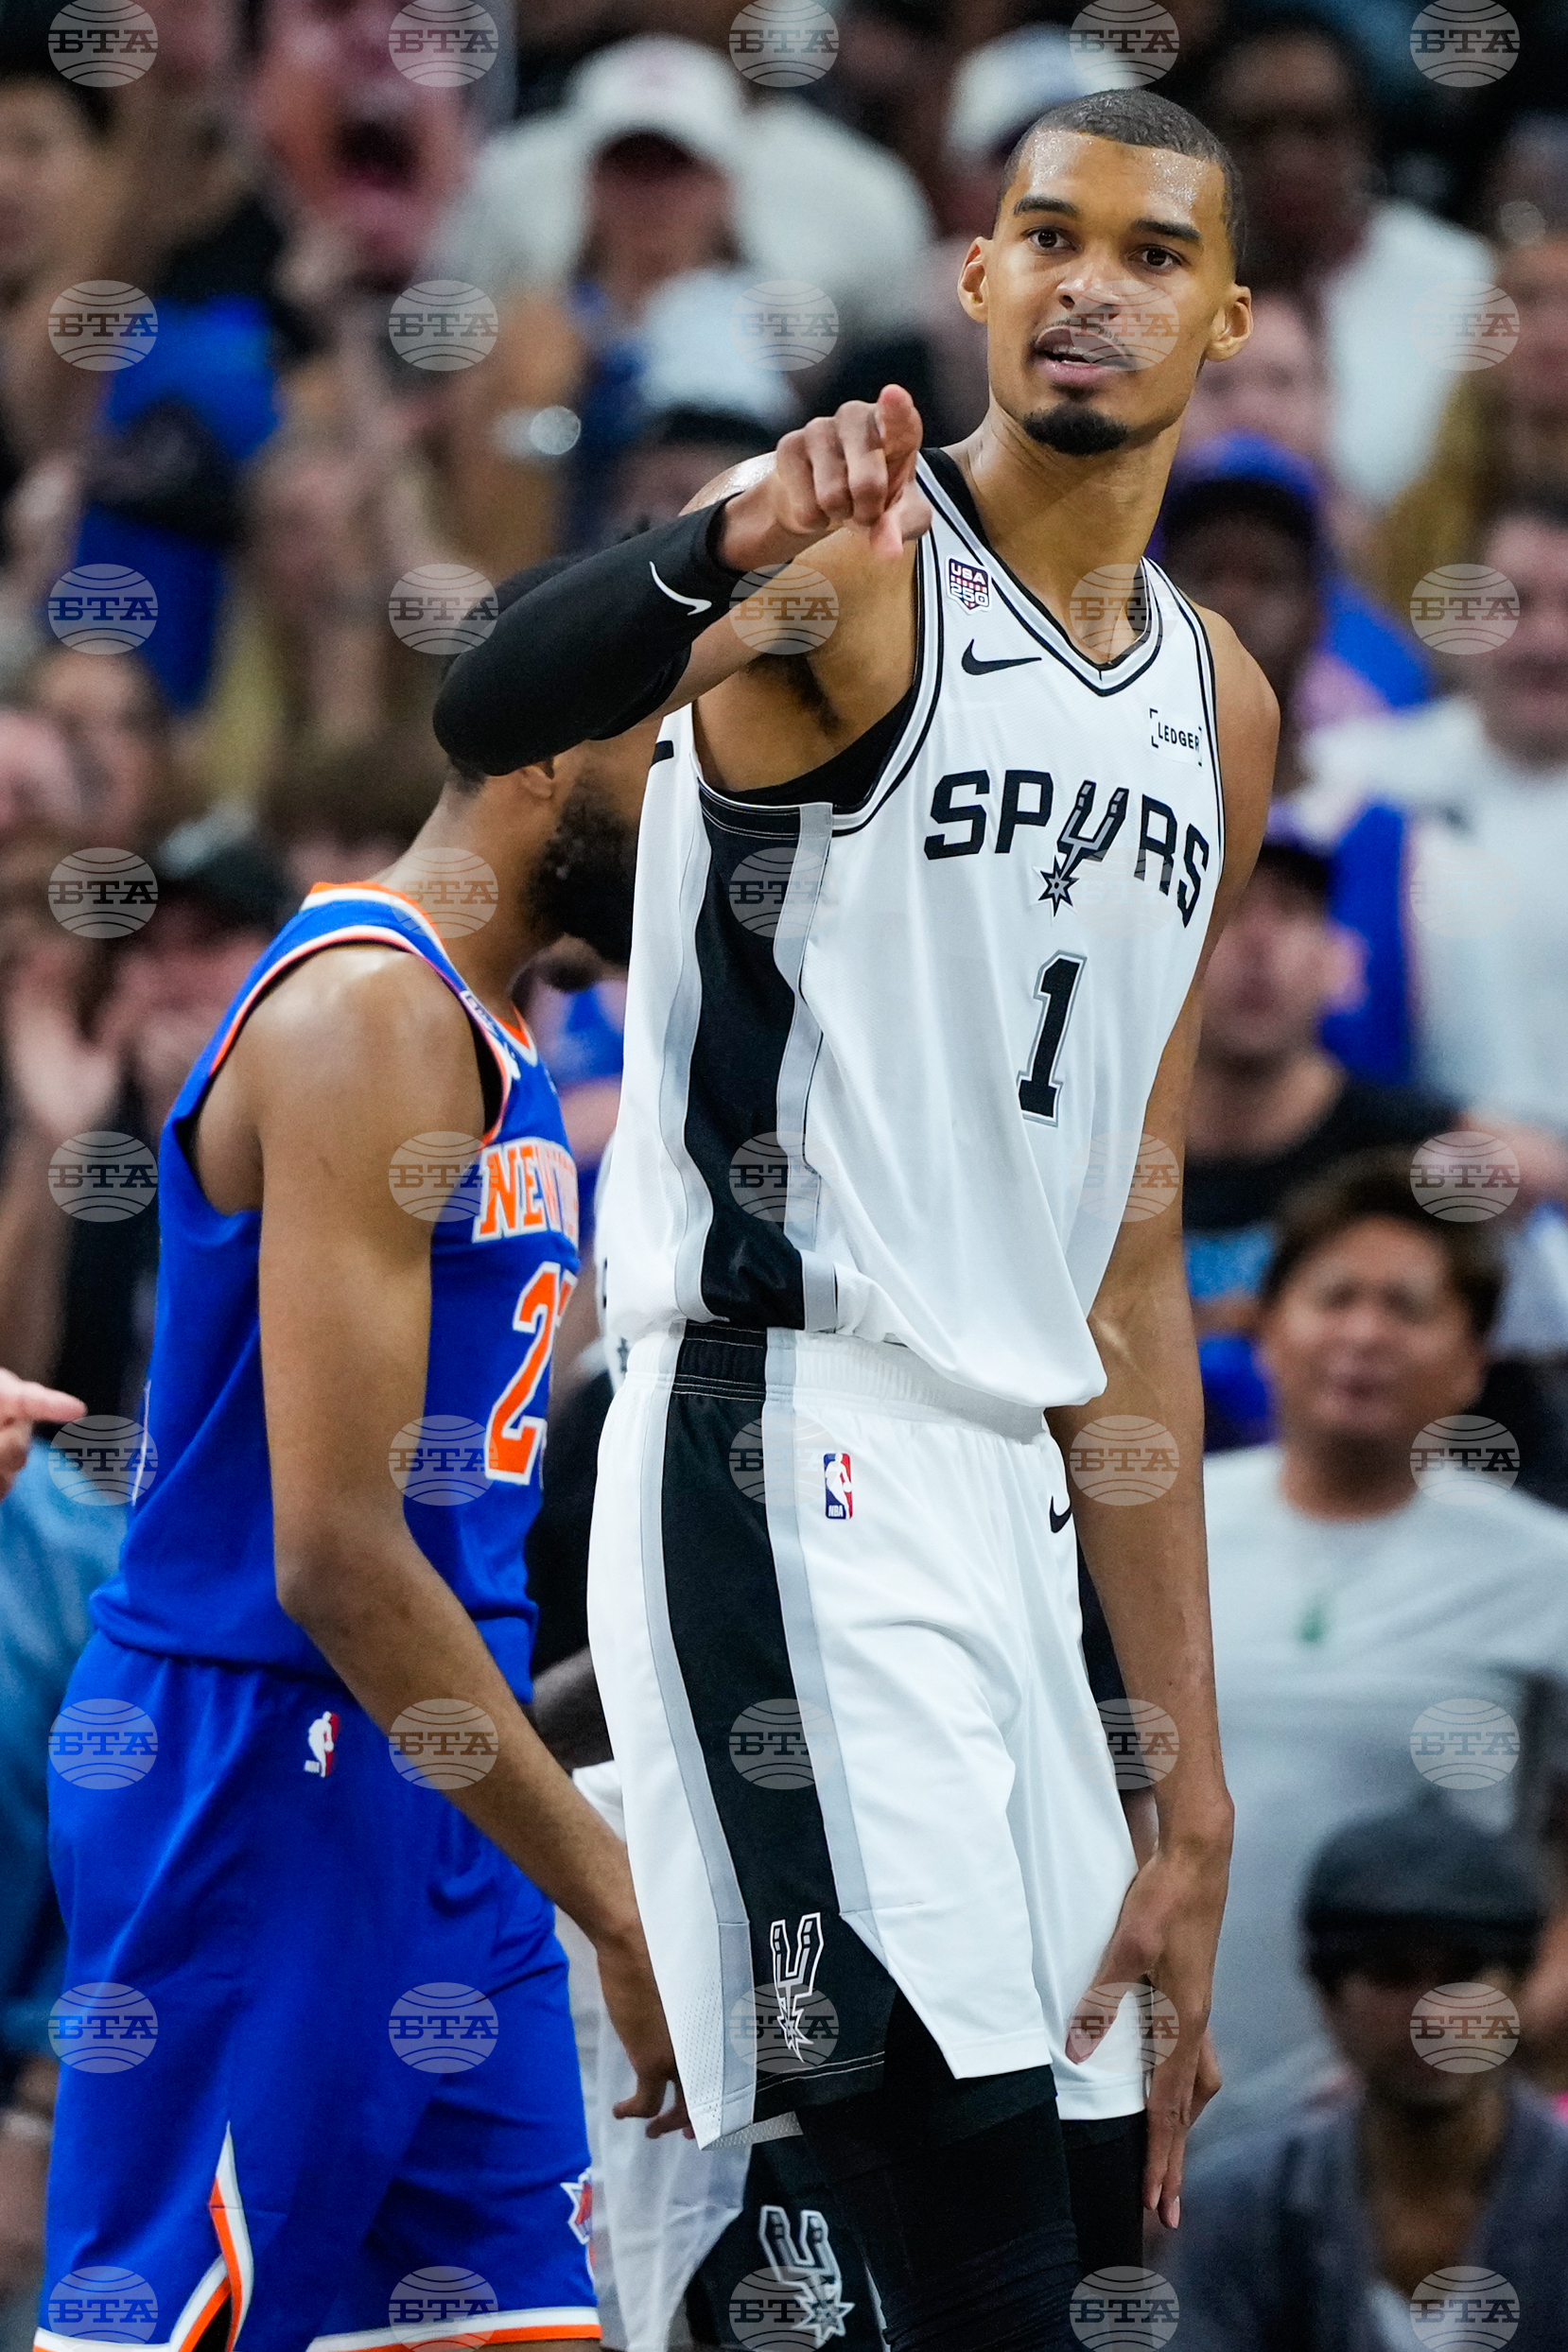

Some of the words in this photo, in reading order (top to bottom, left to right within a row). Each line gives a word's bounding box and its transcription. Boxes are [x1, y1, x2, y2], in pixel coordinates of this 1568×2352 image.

[950, 563, 986, 585] USA
[950, 582, 988, 607] 250
[1159, 722, 1200, 753] LEDGER
[924, 770, 1210, 928] SPURS
[1017, 950, 1088, 1127] 1
[828, 1505, 844, 1517] NBA
